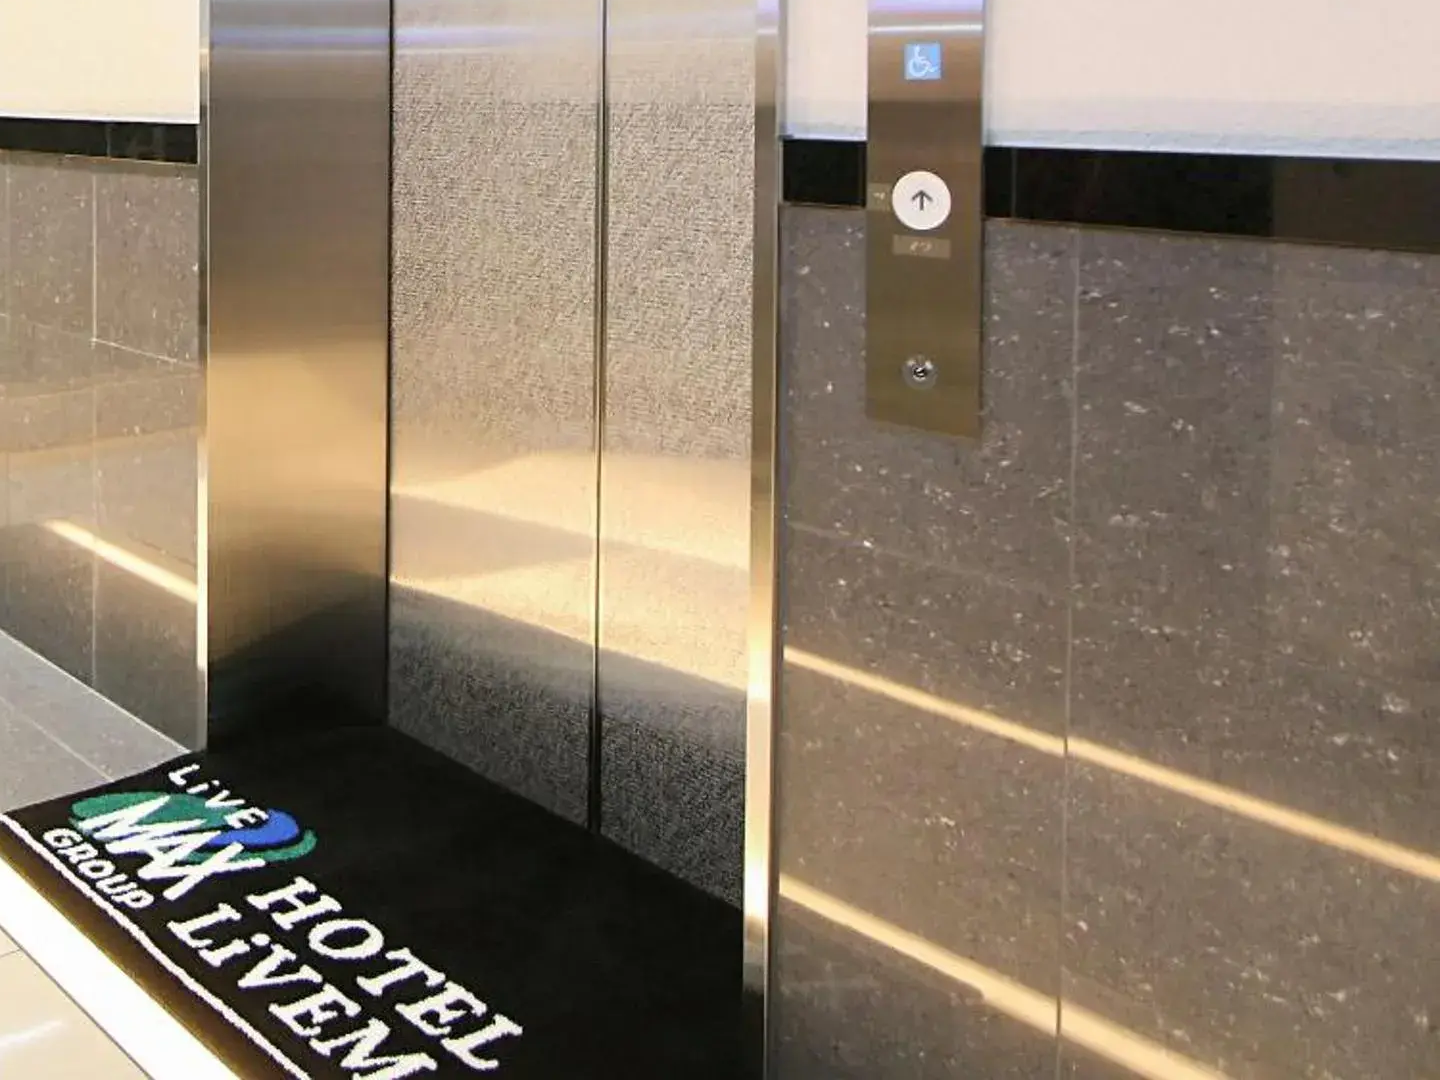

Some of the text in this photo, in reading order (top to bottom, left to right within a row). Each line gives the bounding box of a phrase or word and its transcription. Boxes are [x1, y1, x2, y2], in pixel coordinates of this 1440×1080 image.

[42, 827, 155, 910] GROUP
[82, 794, 266, 902] MAX
[246, 876, 524, 1072] HOTEL
